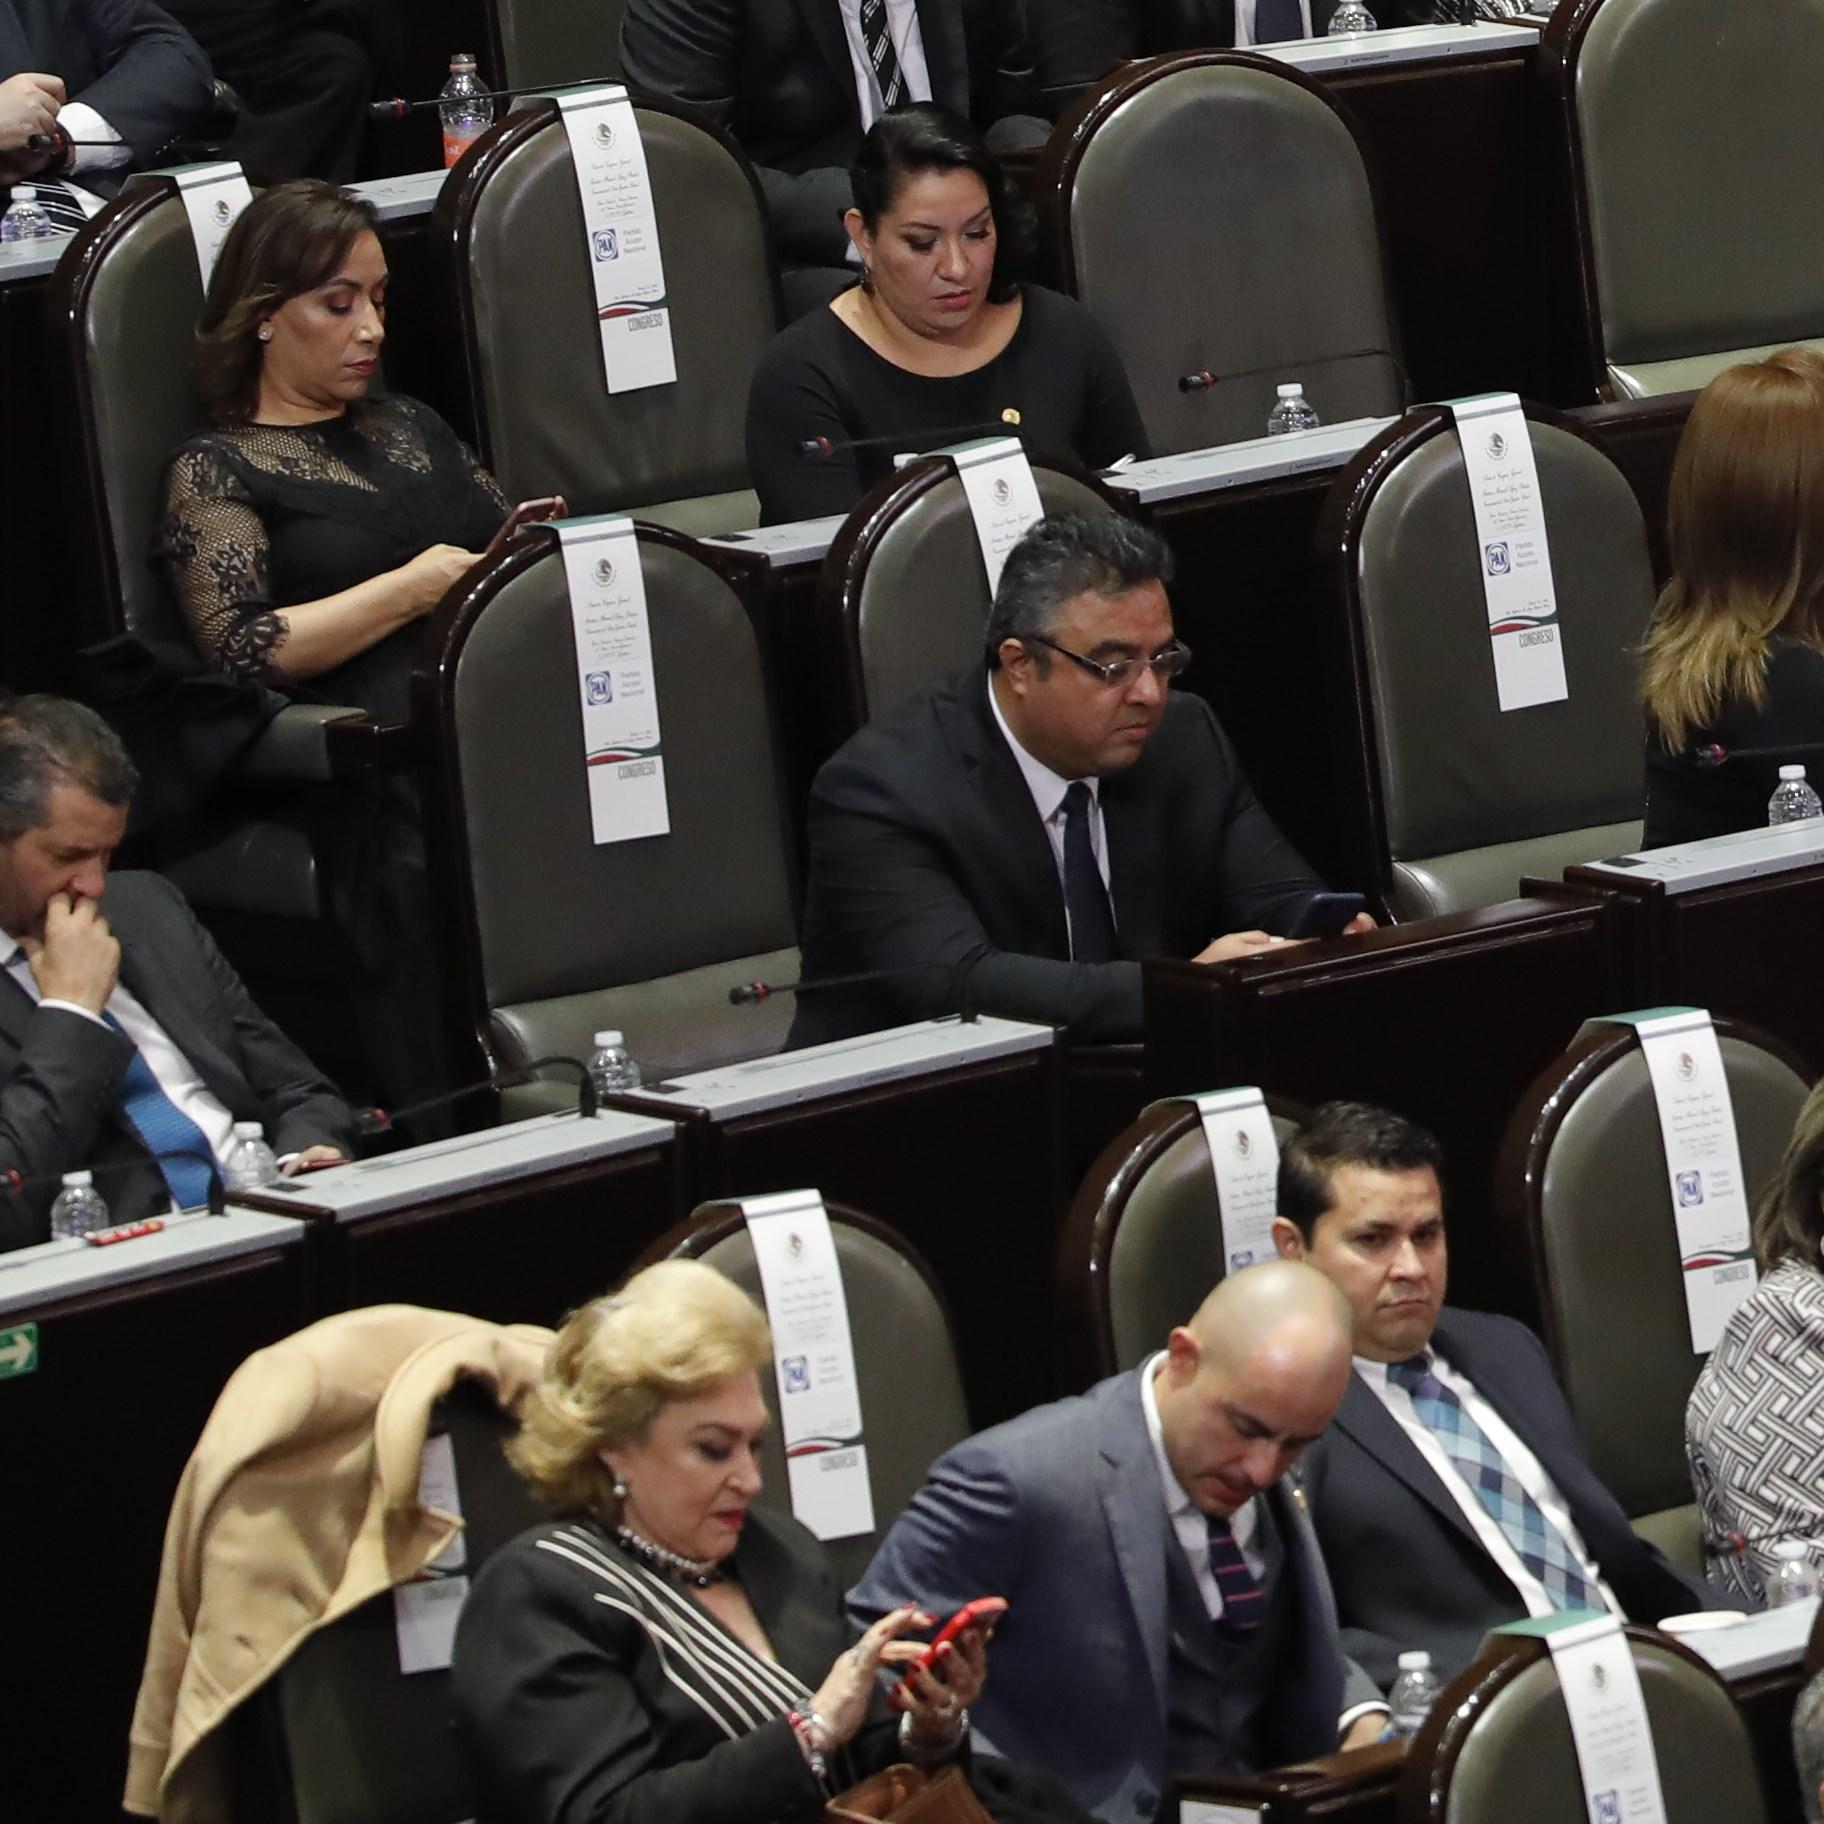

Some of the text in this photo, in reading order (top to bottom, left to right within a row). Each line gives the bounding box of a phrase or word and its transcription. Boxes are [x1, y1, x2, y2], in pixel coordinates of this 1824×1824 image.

[598, 238, 612, 252] PAN
[627, 313, 663, 332] CONGRESO
[1491, 552, 1506, 566] PAN
[1519, 629, 1554, 648] CONGRESO
[591, 680, 606, 694] PAN
[618, 761, 656, 780] CONGRESO
